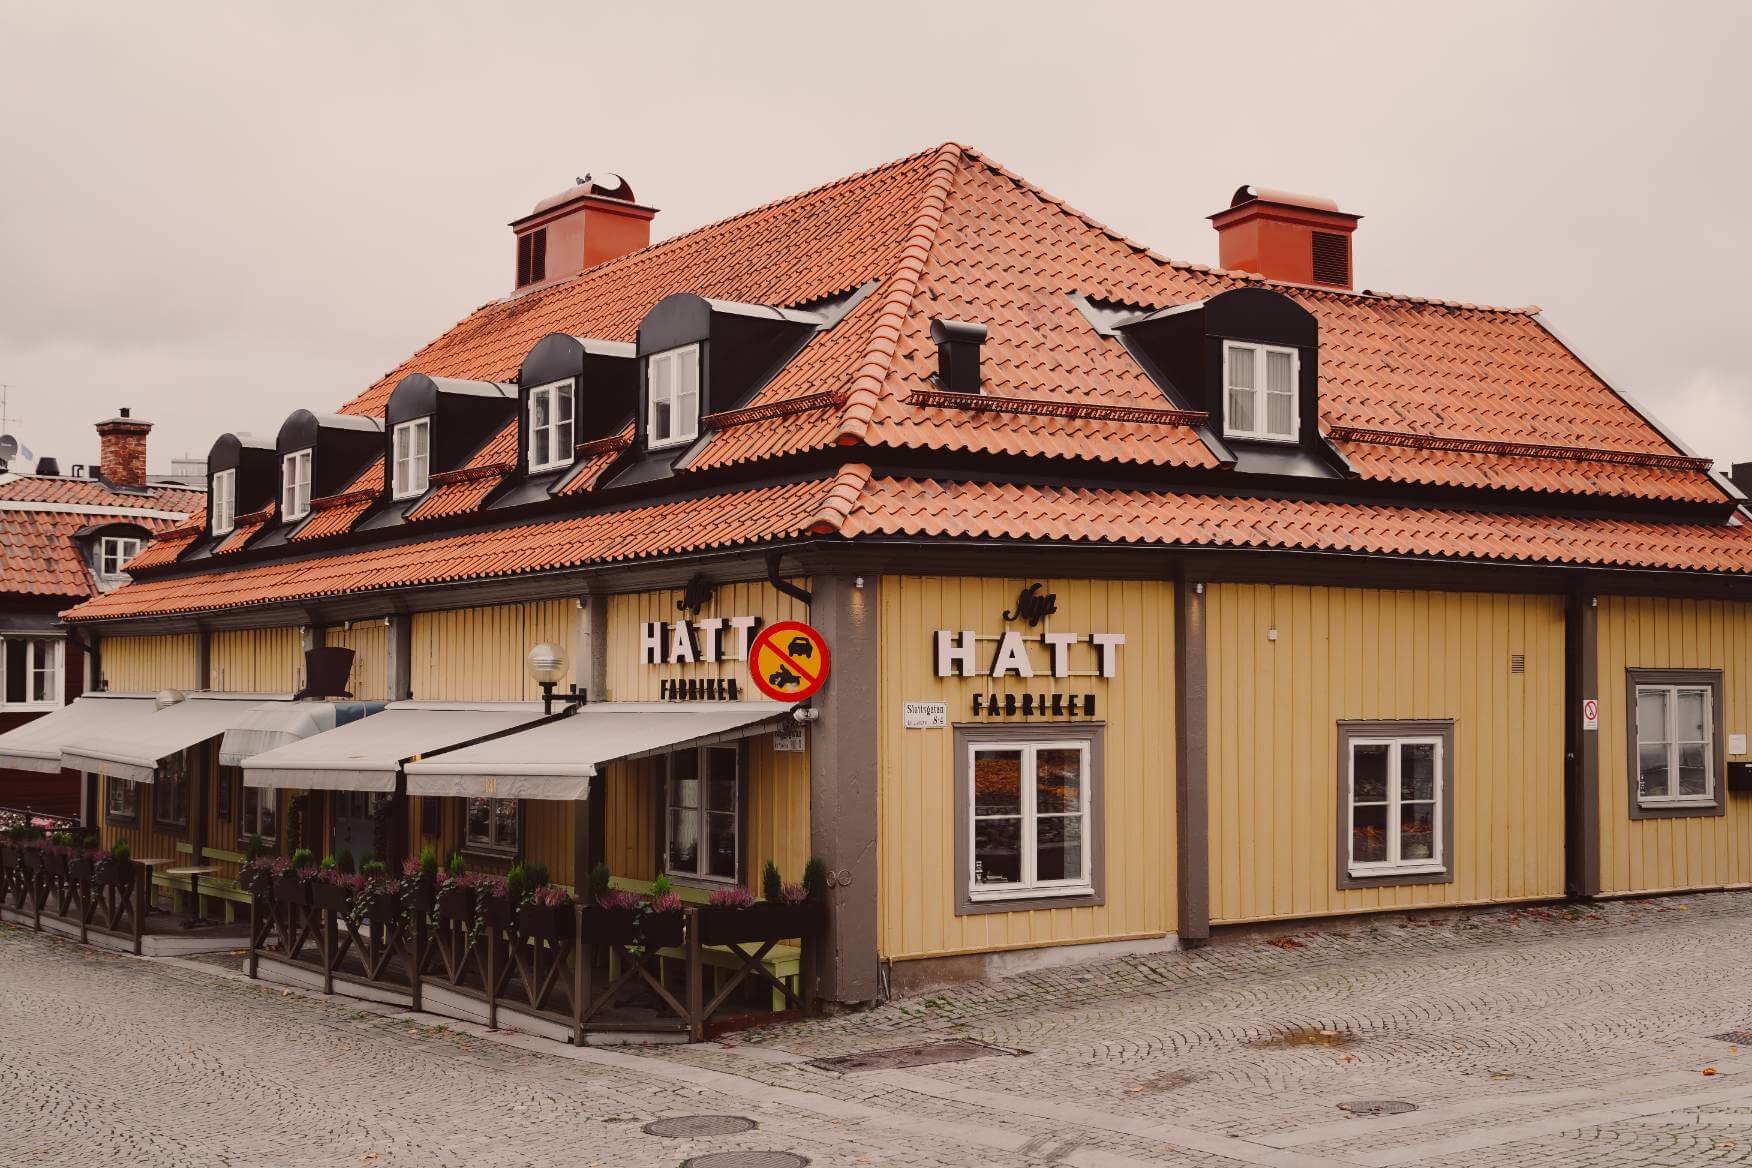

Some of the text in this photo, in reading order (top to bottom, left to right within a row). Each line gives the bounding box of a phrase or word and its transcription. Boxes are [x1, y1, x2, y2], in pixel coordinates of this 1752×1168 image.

[1003, 583, 1057, 627] Nya
[639, 616, 763, 664] HATT
[934, 631, 1126, 678] HATT
[661, 678, 738, 701] FABRIKEN
[972, 693, 1096, 717] FABRIKEN
